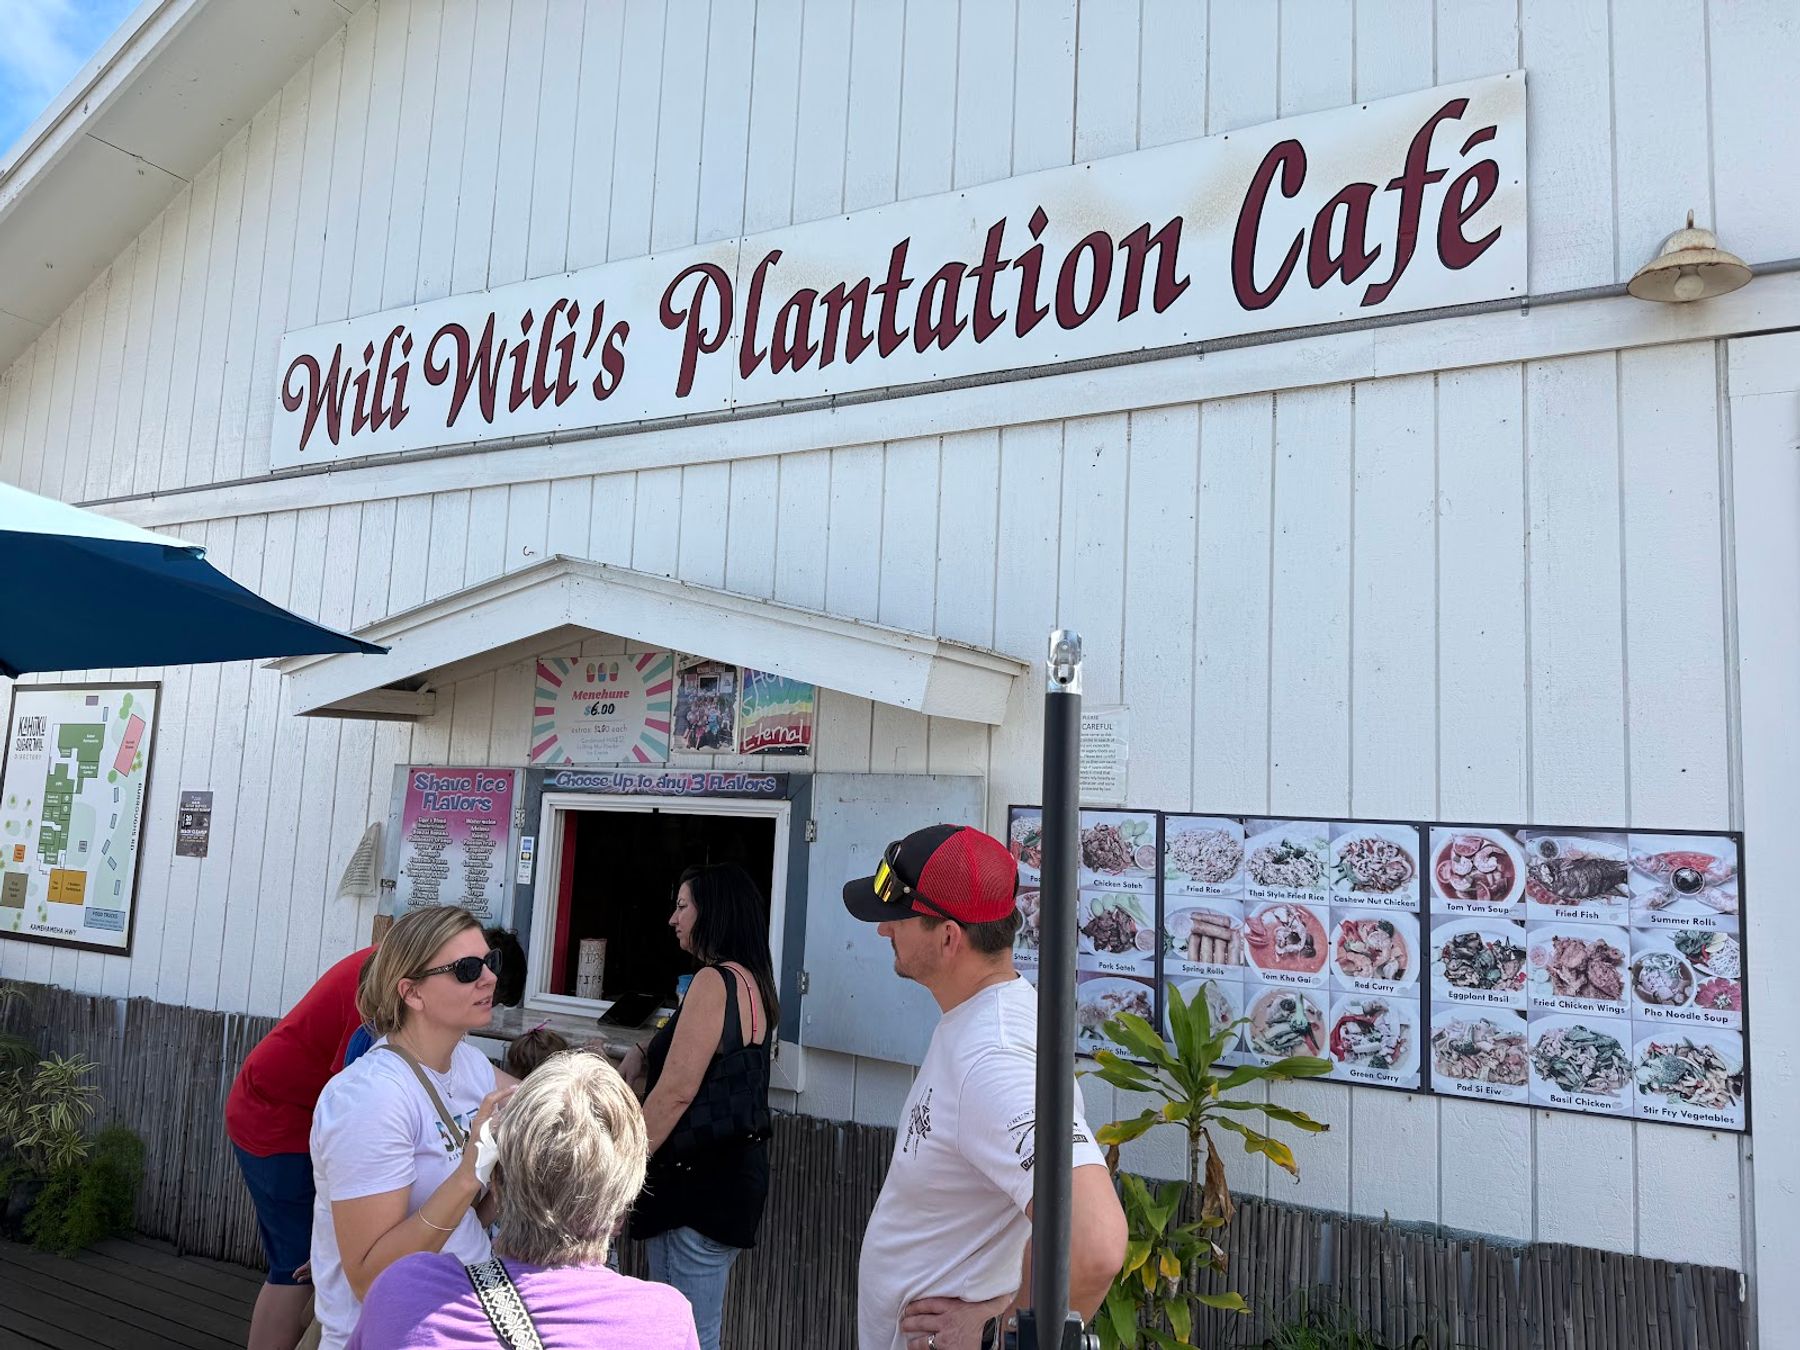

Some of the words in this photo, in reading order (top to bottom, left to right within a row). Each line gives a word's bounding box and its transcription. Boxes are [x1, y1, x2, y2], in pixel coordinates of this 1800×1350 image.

[282, 325, 413, 452] Wili
[423, 298, 630, 428] Wili's
[659, 205, 1191, 398] Plantation
[1231, 97, 1502, 311] Café
[584, 701, 615, 716] $6.00
[1082, 723, 1113, 731] CAREFUL
[743, 720, 804, 750] Eternal
[414, 771, 472, 793] Shave
[475, 772, 508, 794] ice
[555, 771, 609, 788] Choose
[613, 773, 634, 791] Up
[656, 776, 688, 795] any
[690, 773, 706, 791] 3
[1093, 879, 1121, 887] Chicken
[1186, 885, 1203, 893] Fried
[1249, 889, 1265, 898] Thai
[1266, 891, 1285, 900] Style
[1307, 894, 1325, 902] Rice
[1334, 895, 1365, 904] Cashew
[1367, 897, 1382, 905] Nut
[1384, 898, 1416, 907] Chicken
[1446, 903, 1464, 912] Tom
[1466, 904, 1485, 913] Yum
[1487, 906, 1509, 915] Soup
[1555, 909, 1578, 918] Fried
[1580, 911, 1599, 920] Fish
[1650, 914, 1690, 924] Summer
[1693, 917, 1717, 926] Rolls
[1098, 962, 1114, 970] Pork
[1182, 964, 1205, 974] Spring
[1206, 967, 1225, 976] Rolls
[1279, 973, 1296, 982] Kha
[1297, 975, 1312, 984] Gai
[1354, 981, 1370, 990] Red
[1372, 983, 1395, 993] Curry
[1449, 991, 1486, 1002] Eggplant
[1488, 995, 1509, 1003] Basil
[1533, 999, 1556, 1008] Fried
[1558, 1000, 1595, 1011] Chicken
[1597, 1004, 1626, 1015] Wings
[1644, 1008, 1663, 1017] Pho
[1665, 1011, 1701, 1021] Noodle
[1703, 1014, 1729, 1024] Soup
[1350, 1069, 1374, 1079] Green
[1376, 1073, 1400, 1083] Curry
[1456, 1084, 1474, 1092] Pad
[1475, 1085, 1483, 1093] Si
[1484, 1087, 1502, 1095] Eiw
[1550, 1095, 1572, 1104] Basil
[1575, 1098, 1612, 1109] Chicken
[1643, 1106, 1659, 1115] Stir
[1661, 1109, 1678, 1119] Fry
[1680, 1111, 1735, 1125] Vegetables
